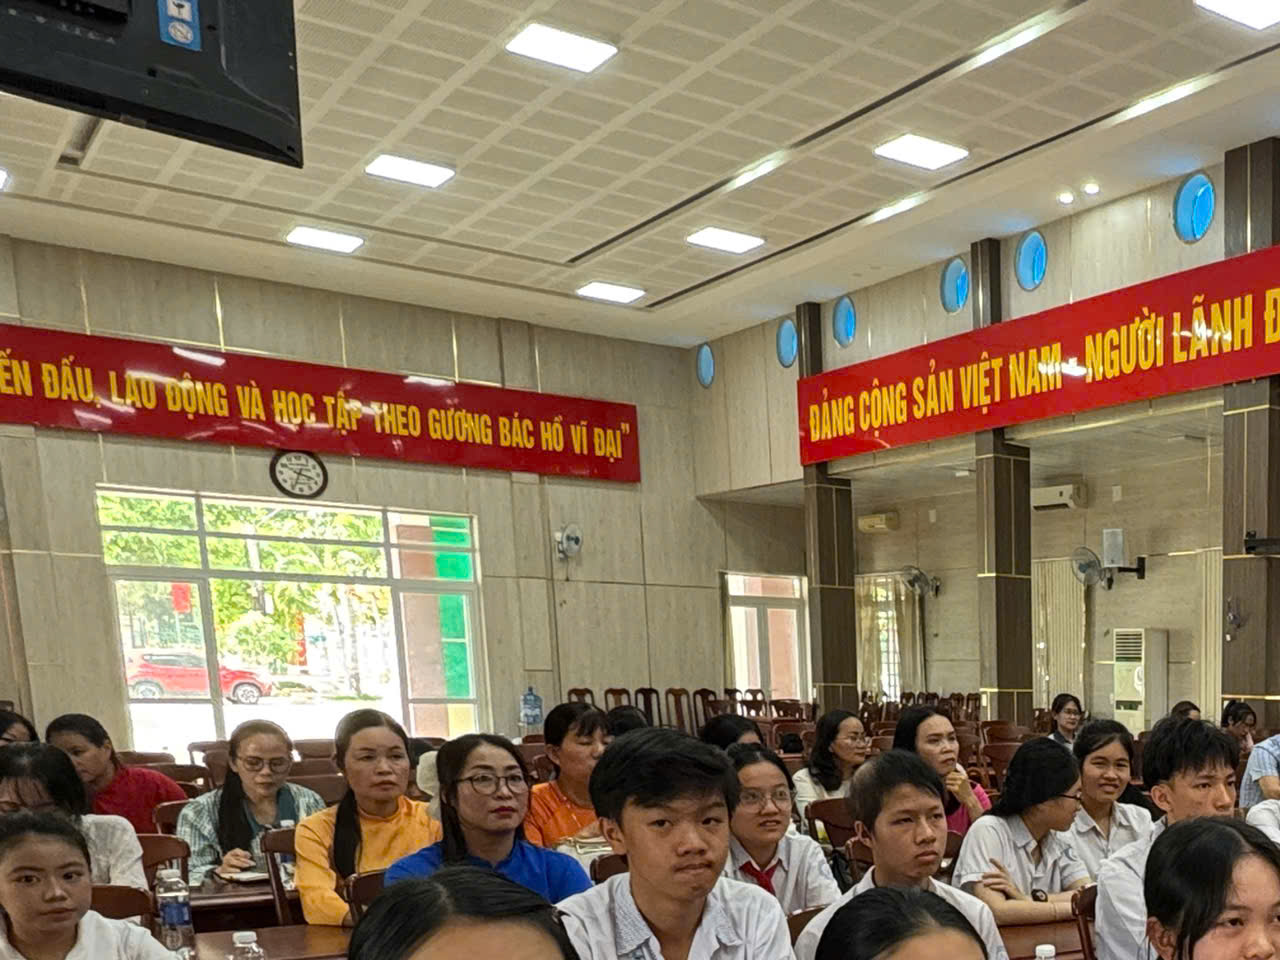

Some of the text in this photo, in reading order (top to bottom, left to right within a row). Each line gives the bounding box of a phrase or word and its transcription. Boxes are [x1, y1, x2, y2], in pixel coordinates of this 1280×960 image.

[109, 369, 158, 410] LAO
[166, 371, 230, 420] ĐỘNG
[236, 380, 266, 422] VÀ
[271, 388, 316, 431] HỌC
[322, 389, 363, 436] TẬP
[370, 400, 421, 438] THEO
[427, 407, 493, 445] GƯƠNG
[498, 411, 535, 449] BÁC
[540, 414, 564, 452] HỒ
[570, 420, 589, 455] VĨ
[809, 387, 855, 442] ĐẢNG
[859, 378, 907, 438] CỘNG
[912, 359, 954, 420] SẢN
[959, 351, 1004, 415] VIỆT
[1009, 342, 1062, 400] NAM
[1085, 306, 1165, 384] NGƯỜI
[1172, 294, 1253, 364] LÃNH
